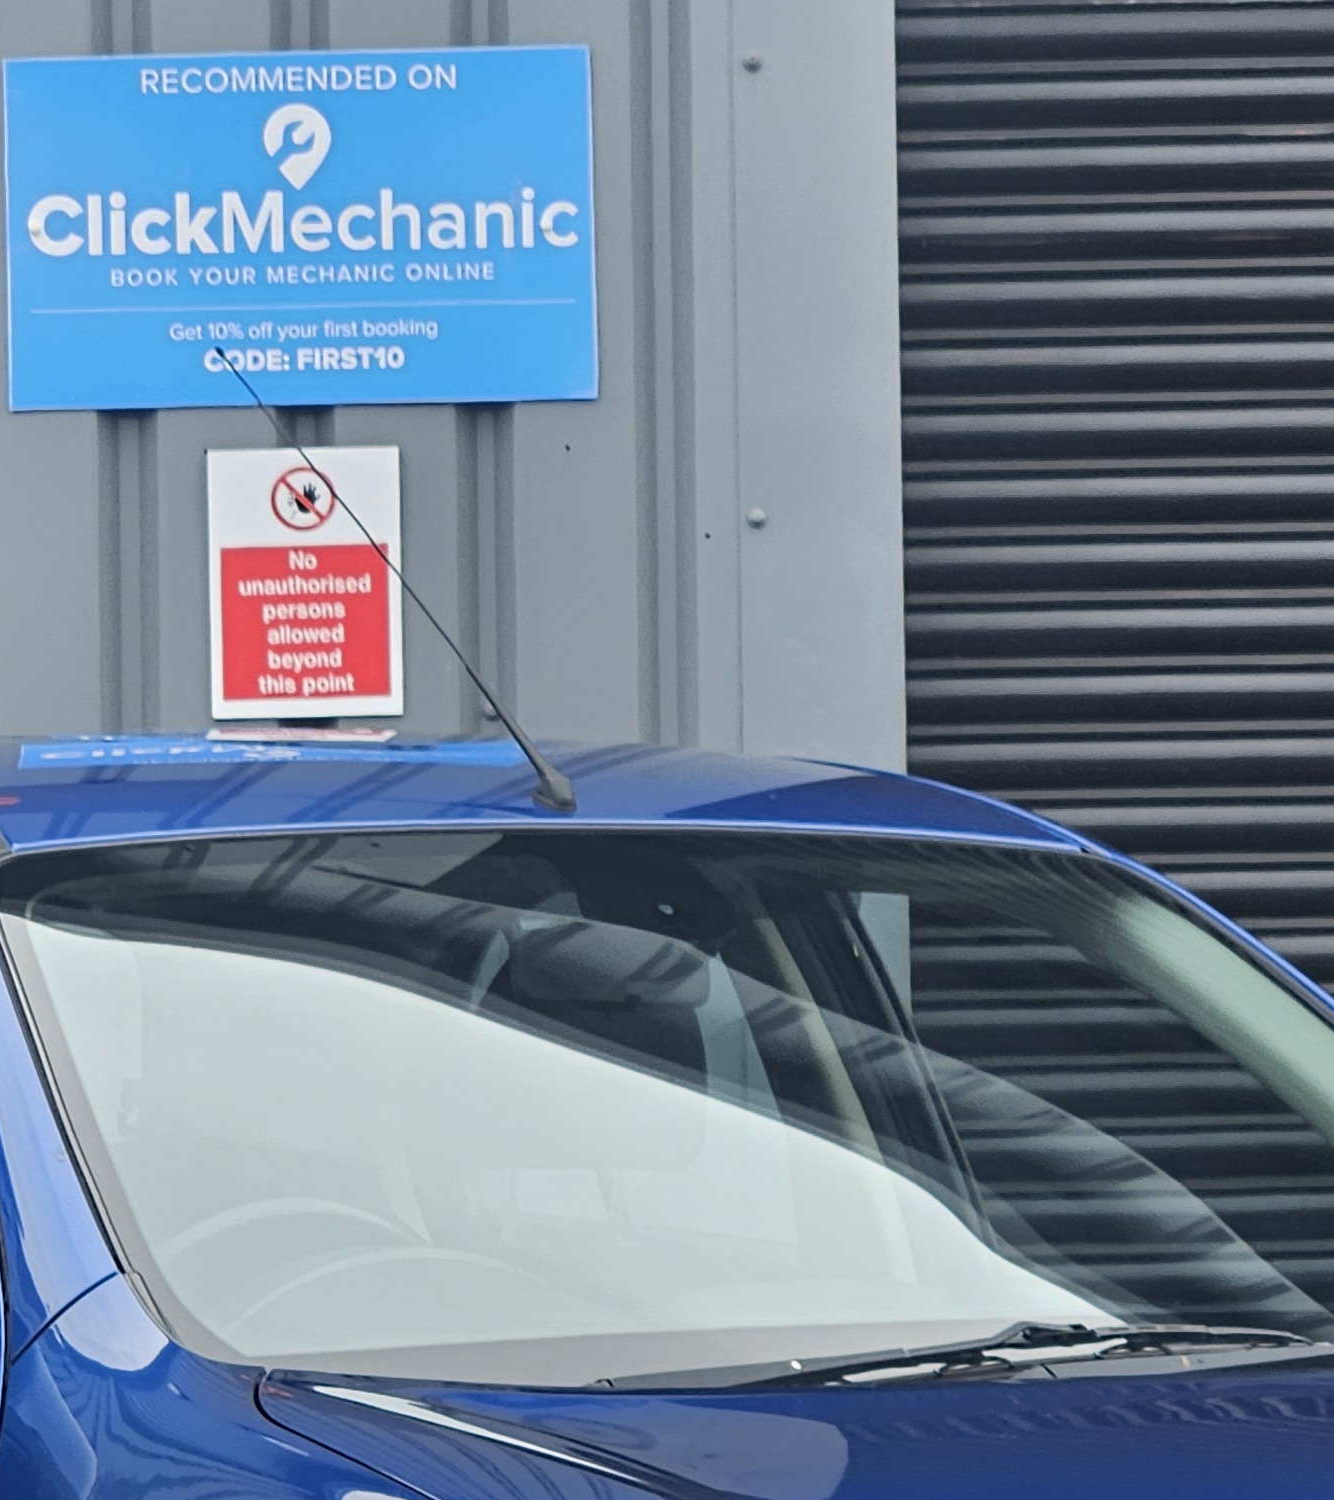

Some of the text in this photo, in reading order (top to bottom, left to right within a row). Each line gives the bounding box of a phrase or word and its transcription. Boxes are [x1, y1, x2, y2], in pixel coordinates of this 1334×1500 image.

[140, 64, 457, 94] RECOMMENDED ON
[28, 187, 579, 256] ClickMechanic
[110, 261, 494, 287] BOOK YOUR MECHANIC ONLINE
[169, 318, 438, 342] Get 10% off your first booking
[203, 345, 406, 373] CODE: FIRST10
[288, 550, 317, 570] No
[238, 573, 371, 596] unauthorised
[262, 601, 346, 623] persons
[267, 624, 345, 644] allowed
[267, 648, 343, 672] beyond
[258, 672, 355, 697] this point
